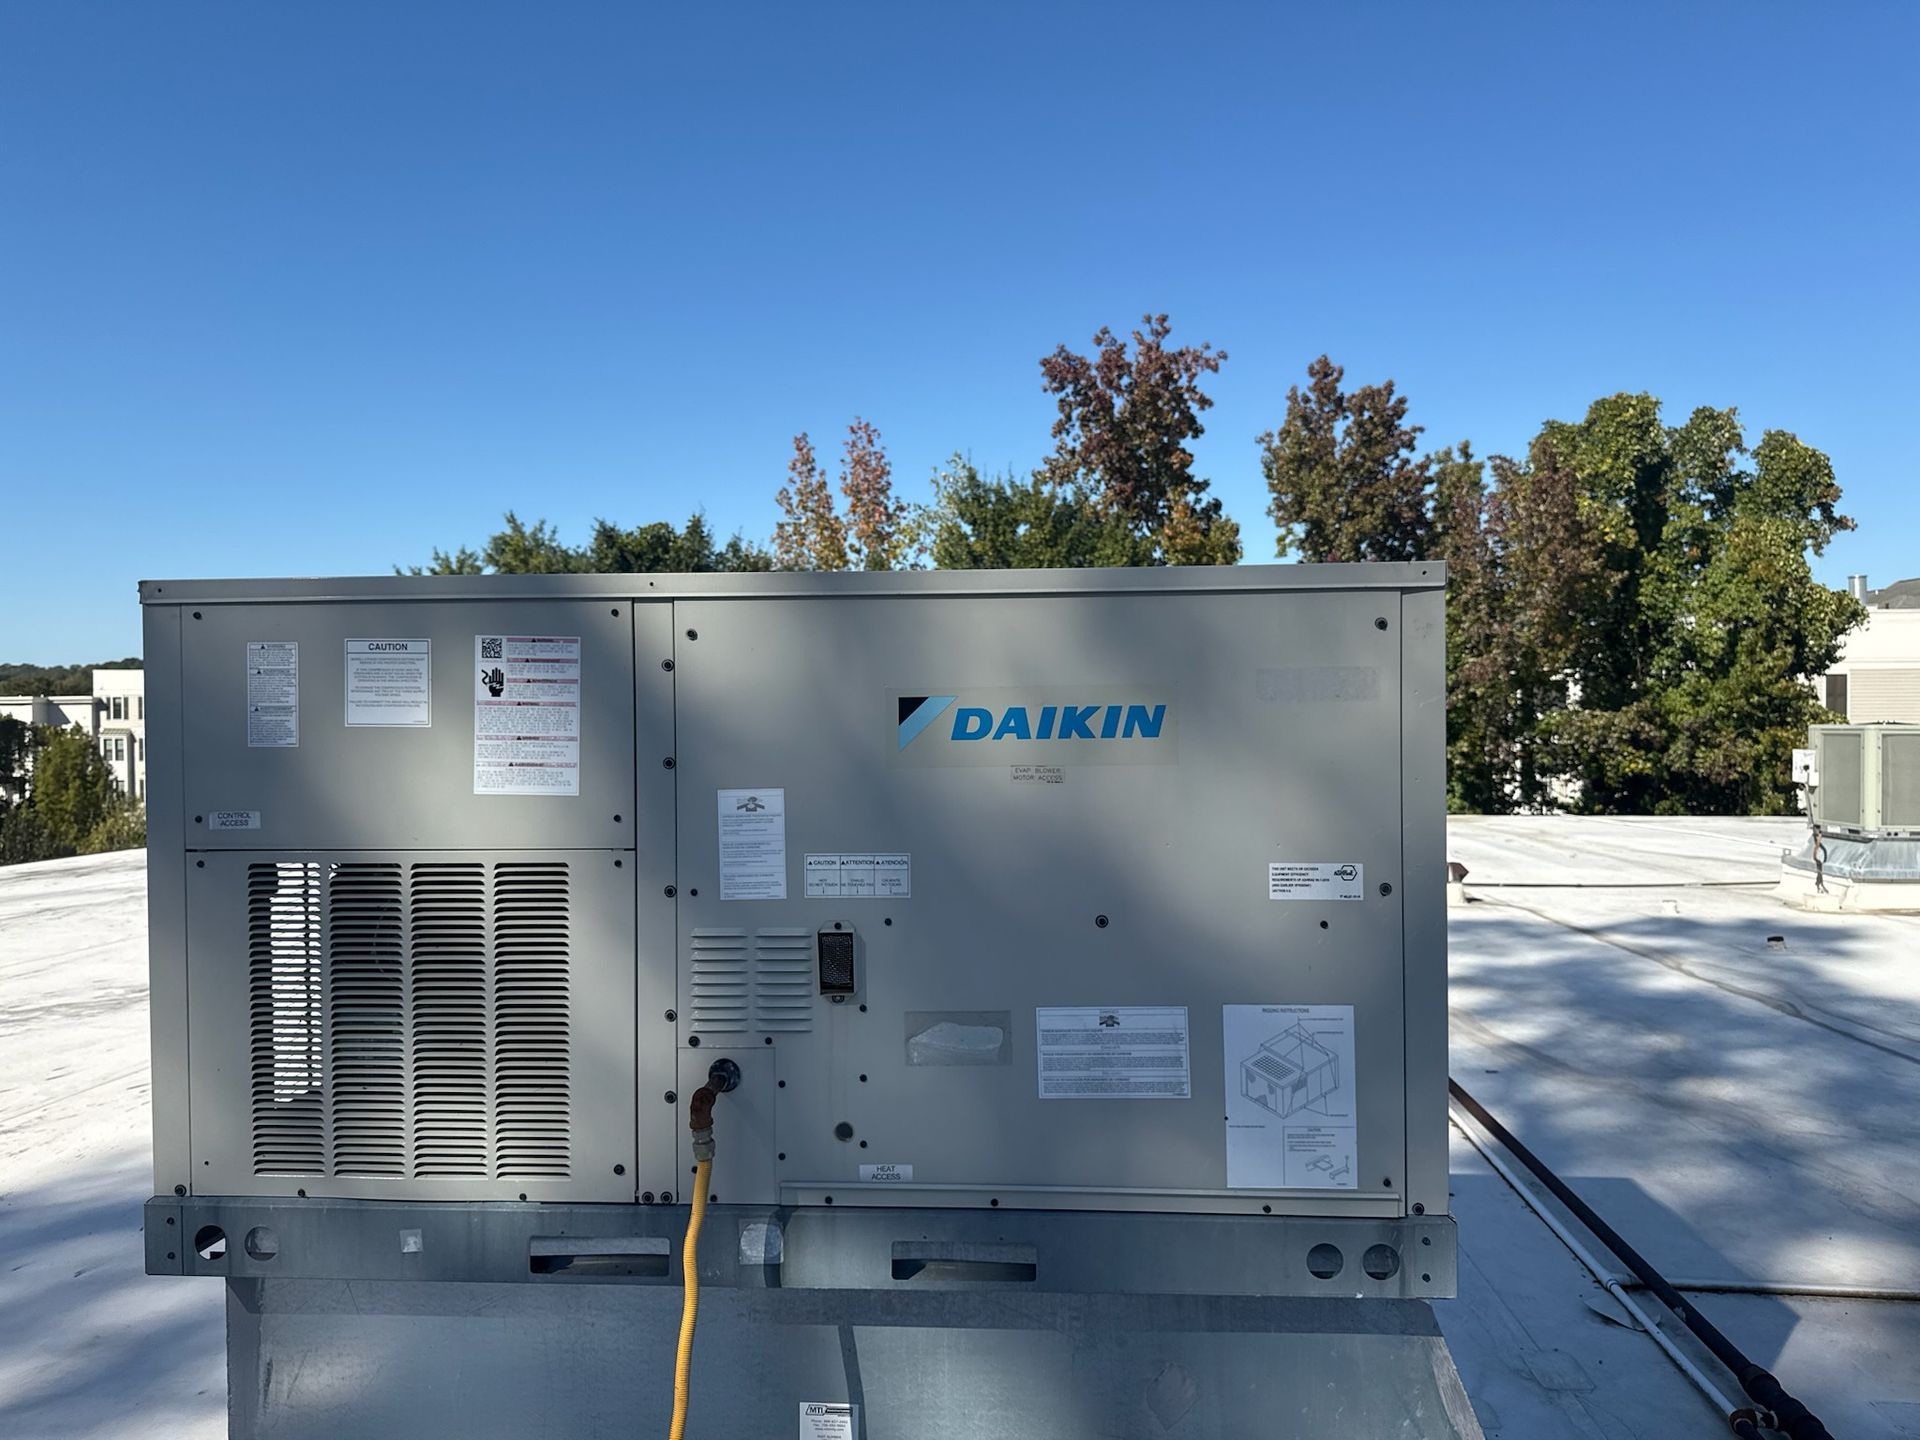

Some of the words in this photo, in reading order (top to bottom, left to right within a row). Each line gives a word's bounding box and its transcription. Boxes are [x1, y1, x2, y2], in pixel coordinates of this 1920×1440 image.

[368, 642, 408, 651] CAUTION
[951, 704, 1167, 741] DAIKIN
[217, 812, 252, 820] CONTROL
[220, 819, 249, 827] ACCESS
[876, 1165, 896, 1173] HEAT
[871, 1173, 901, 1181] ACCESS
[809, 1406, 824, 1414] MTI
